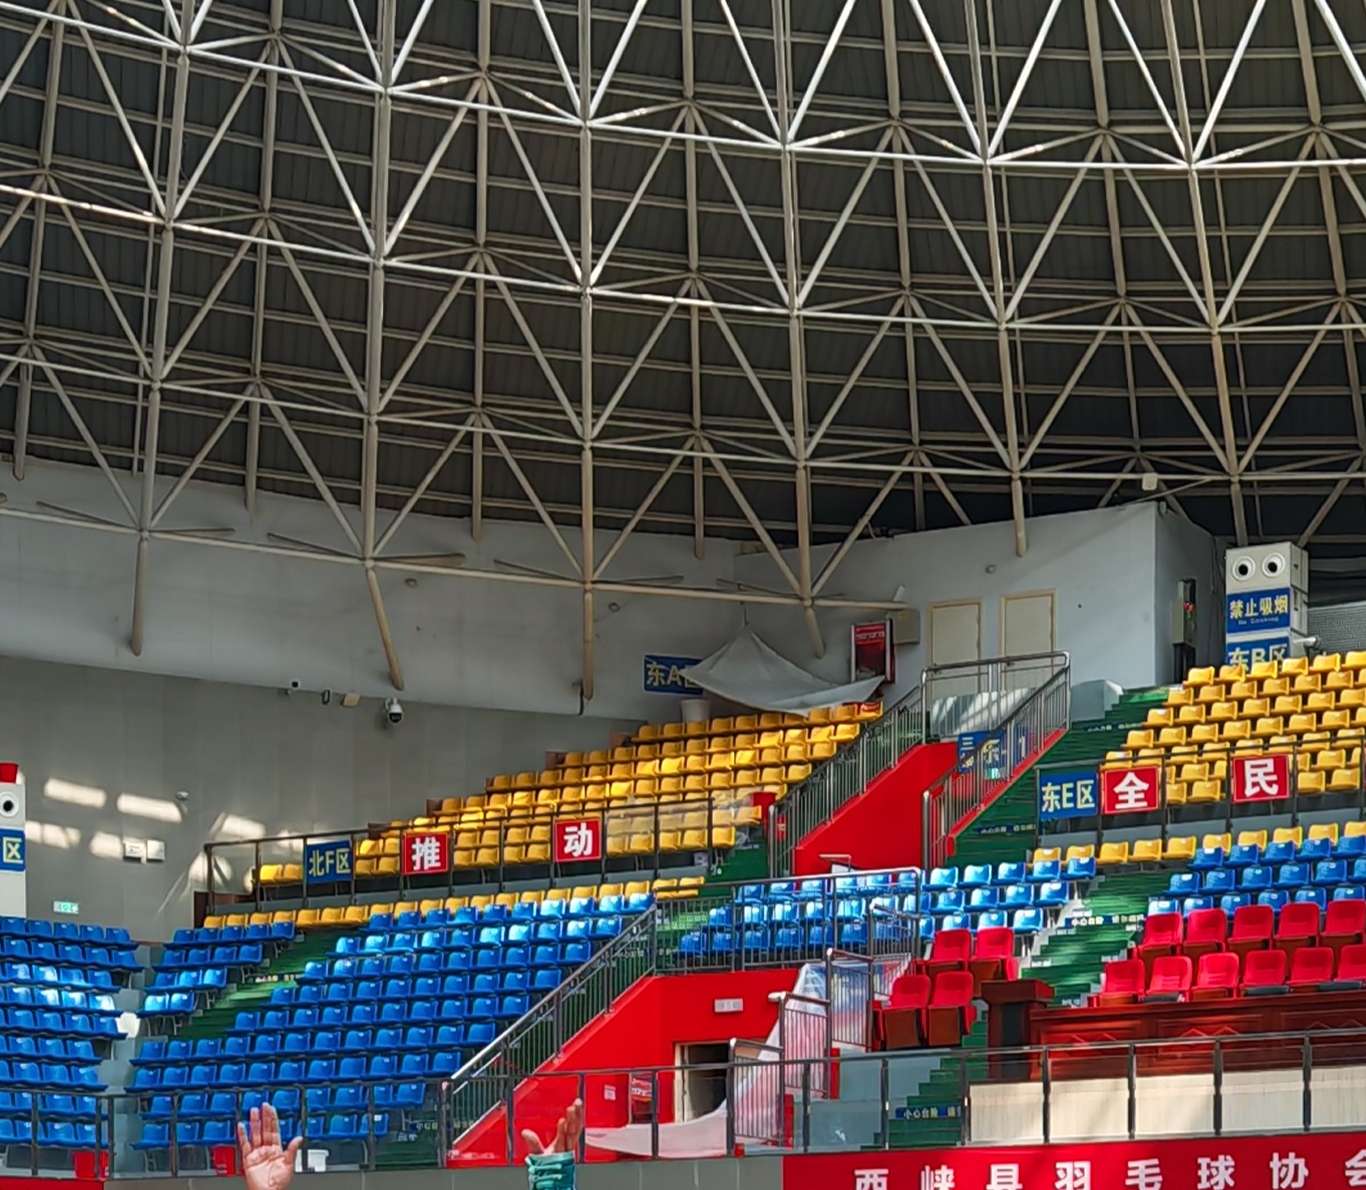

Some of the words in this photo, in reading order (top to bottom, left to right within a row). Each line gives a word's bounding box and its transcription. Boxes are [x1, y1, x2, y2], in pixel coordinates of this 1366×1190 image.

[1229, 594, 1289, 620] 禁止吸烟
[1041, 780, 1096, 812] 东E区
[1114, 772, 1151, 811] 全
[1243, 760, 1279, 797] 民
[308, 848, 351, 877] 北F区
[411, 836, 441, 870] 推
[563, 823, 594, 856] 动
